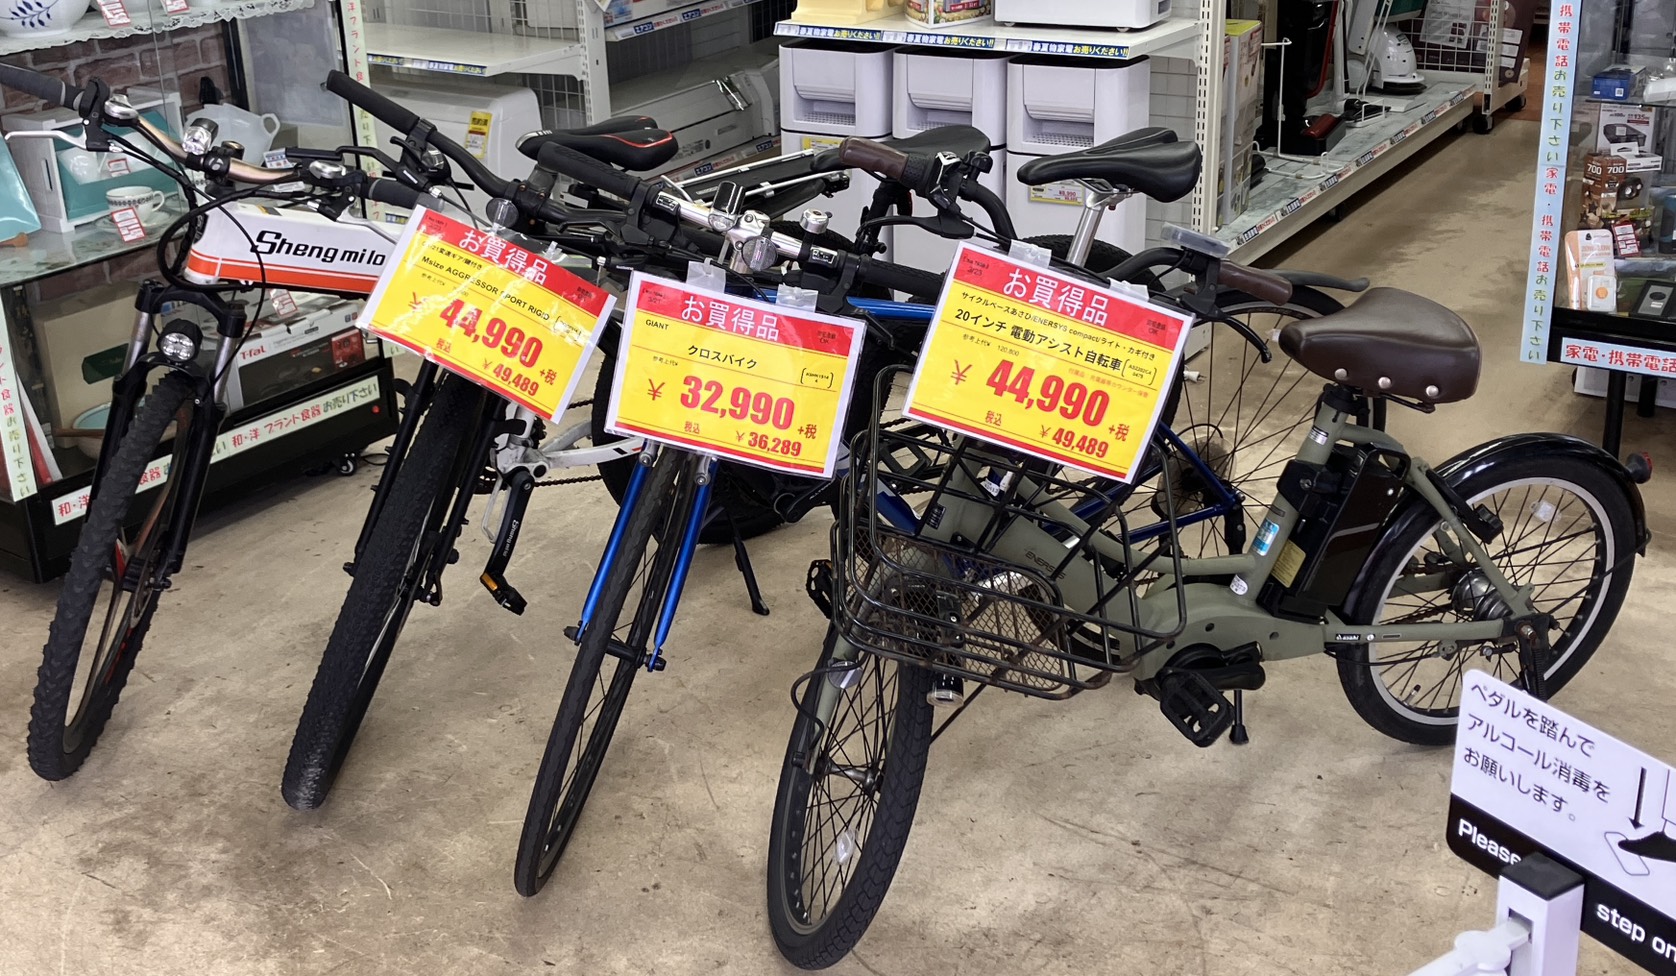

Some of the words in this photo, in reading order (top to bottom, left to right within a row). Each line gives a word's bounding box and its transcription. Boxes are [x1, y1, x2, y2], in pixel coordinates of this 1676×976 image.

[1546, 4, 1573, 162] 携帯電話お売り下さい
[1607, 166, 1625, 174] 700
[421, 255, 445, 271] Msize
[458, 229, 549, 286] お買得品
[1527, 167, 1560, 362] 家電・携帯電話お売り下さい
[1003, 268, 1109, 326] お買得品
[440, 298, 543, 369] 44,990
[645, 318, 669, 331] GIANT
[681, 295, 780, 342] お買得品
[687, 344, 758, 370] クロスバイク
[955, 308, 1007, 332] 20インチ
[1010, 324, 1122, 372] 電動アシスト自転車
[493, 363, 540, 397] 49,489
[539, 368, 557, 386] +税
[986, 359, 1110, 427] 44,990
[647, 378, 665, 401] ¥
[680, 375, 795, 430] 32,990
[984, 410, 1002, 426] 税込
[684, 420, 701, 435] 税込
[748, 431, 802, 457] 36,289
[797, 423, 817, 440] +税
[1051, 427, 1110, 459] 49,489
[1108, 423, 1130, 442] +税
[1470, 683, 1596, 758] ペダルを踏んで
[1467, 713, 1612, 804] アルコール消毒を
[1463, 746, 1577, 822] お願いします。
[1596, 903, 1646, 943] step
